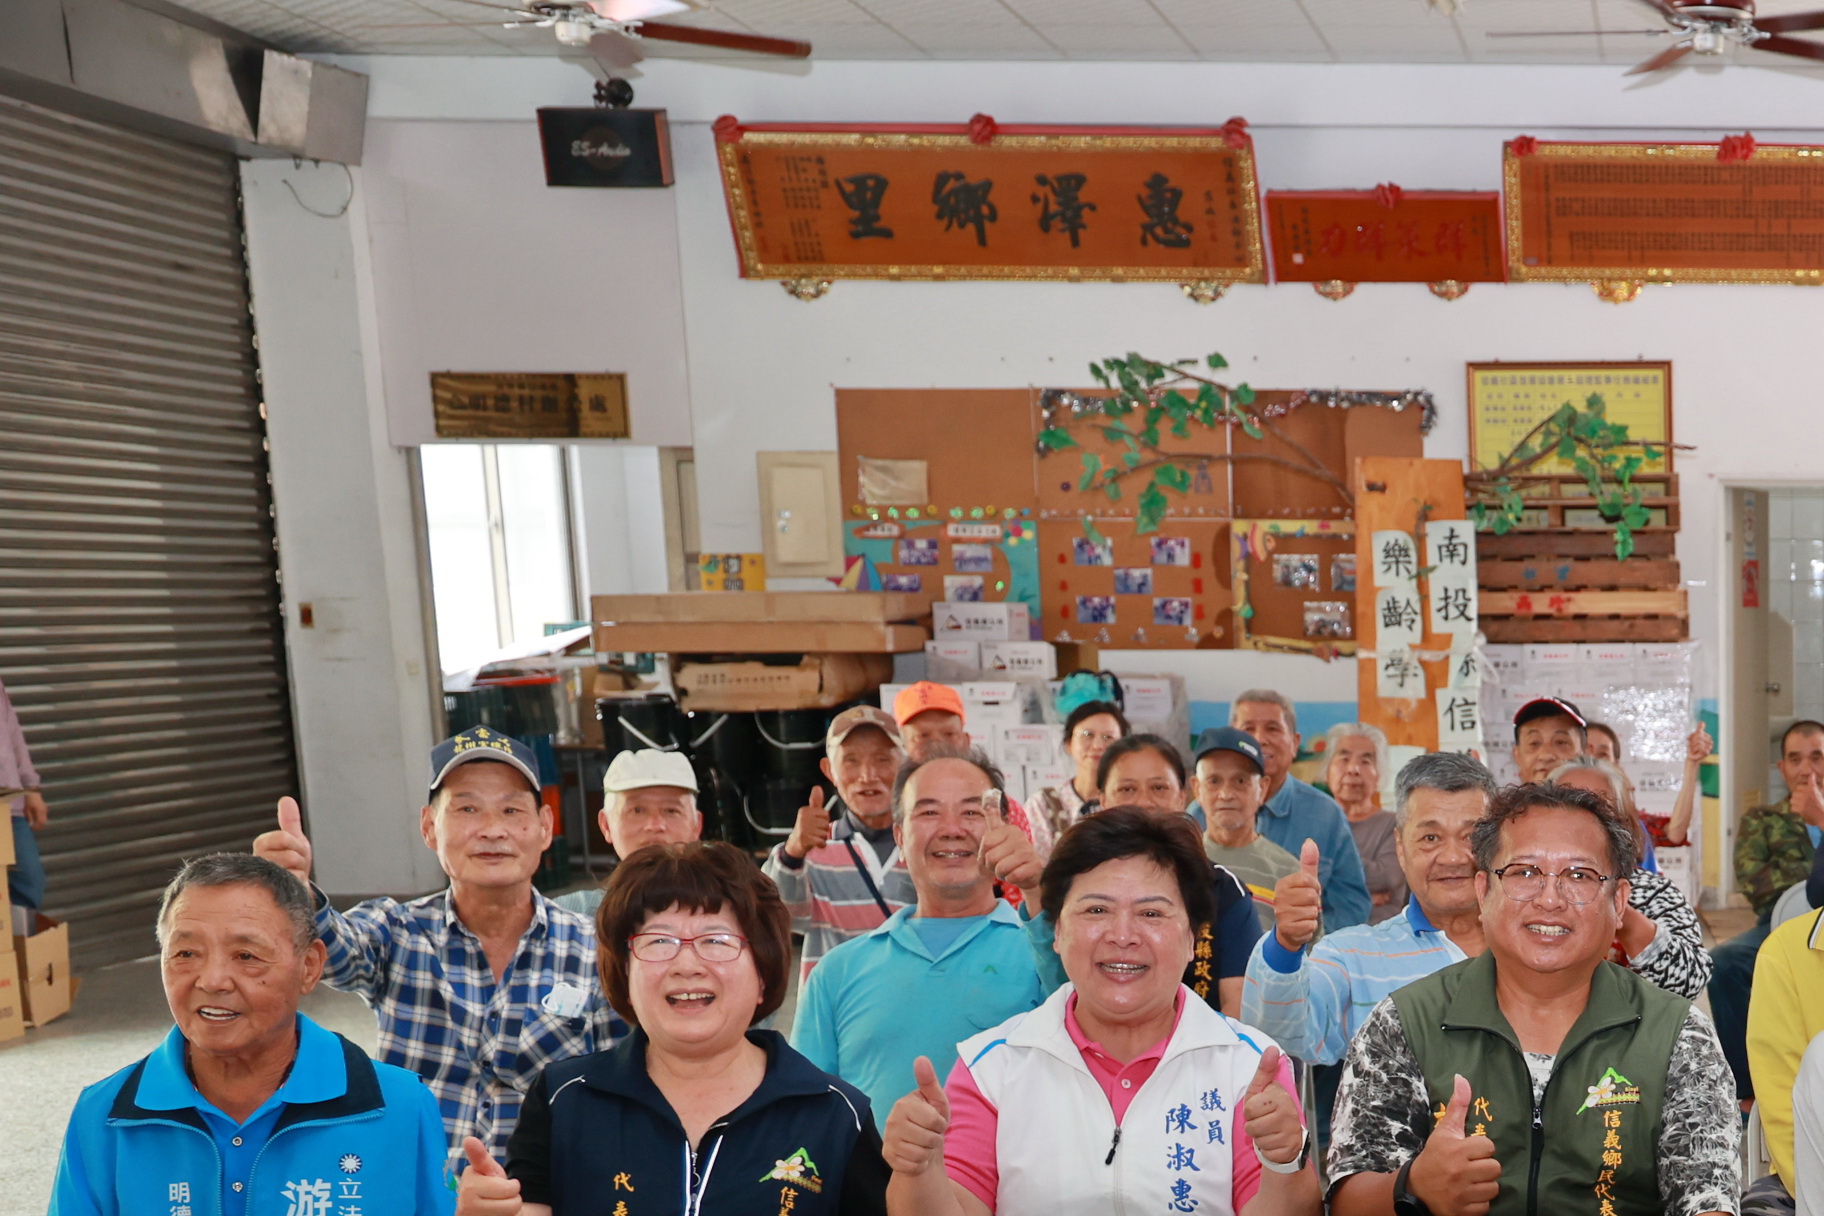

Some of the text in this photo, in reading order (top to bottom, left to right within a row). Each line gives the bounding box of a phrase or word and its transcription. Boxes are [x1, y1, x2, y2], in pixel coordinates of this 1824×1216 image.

[570, 140, 632, 159] ES-Audio
[833, 168, 1195, 249] 惠澤鄉里
[1200, 1088, 1227, 1146] 議員
[1165, 1102, 1201, 1214] 陳淑惠
